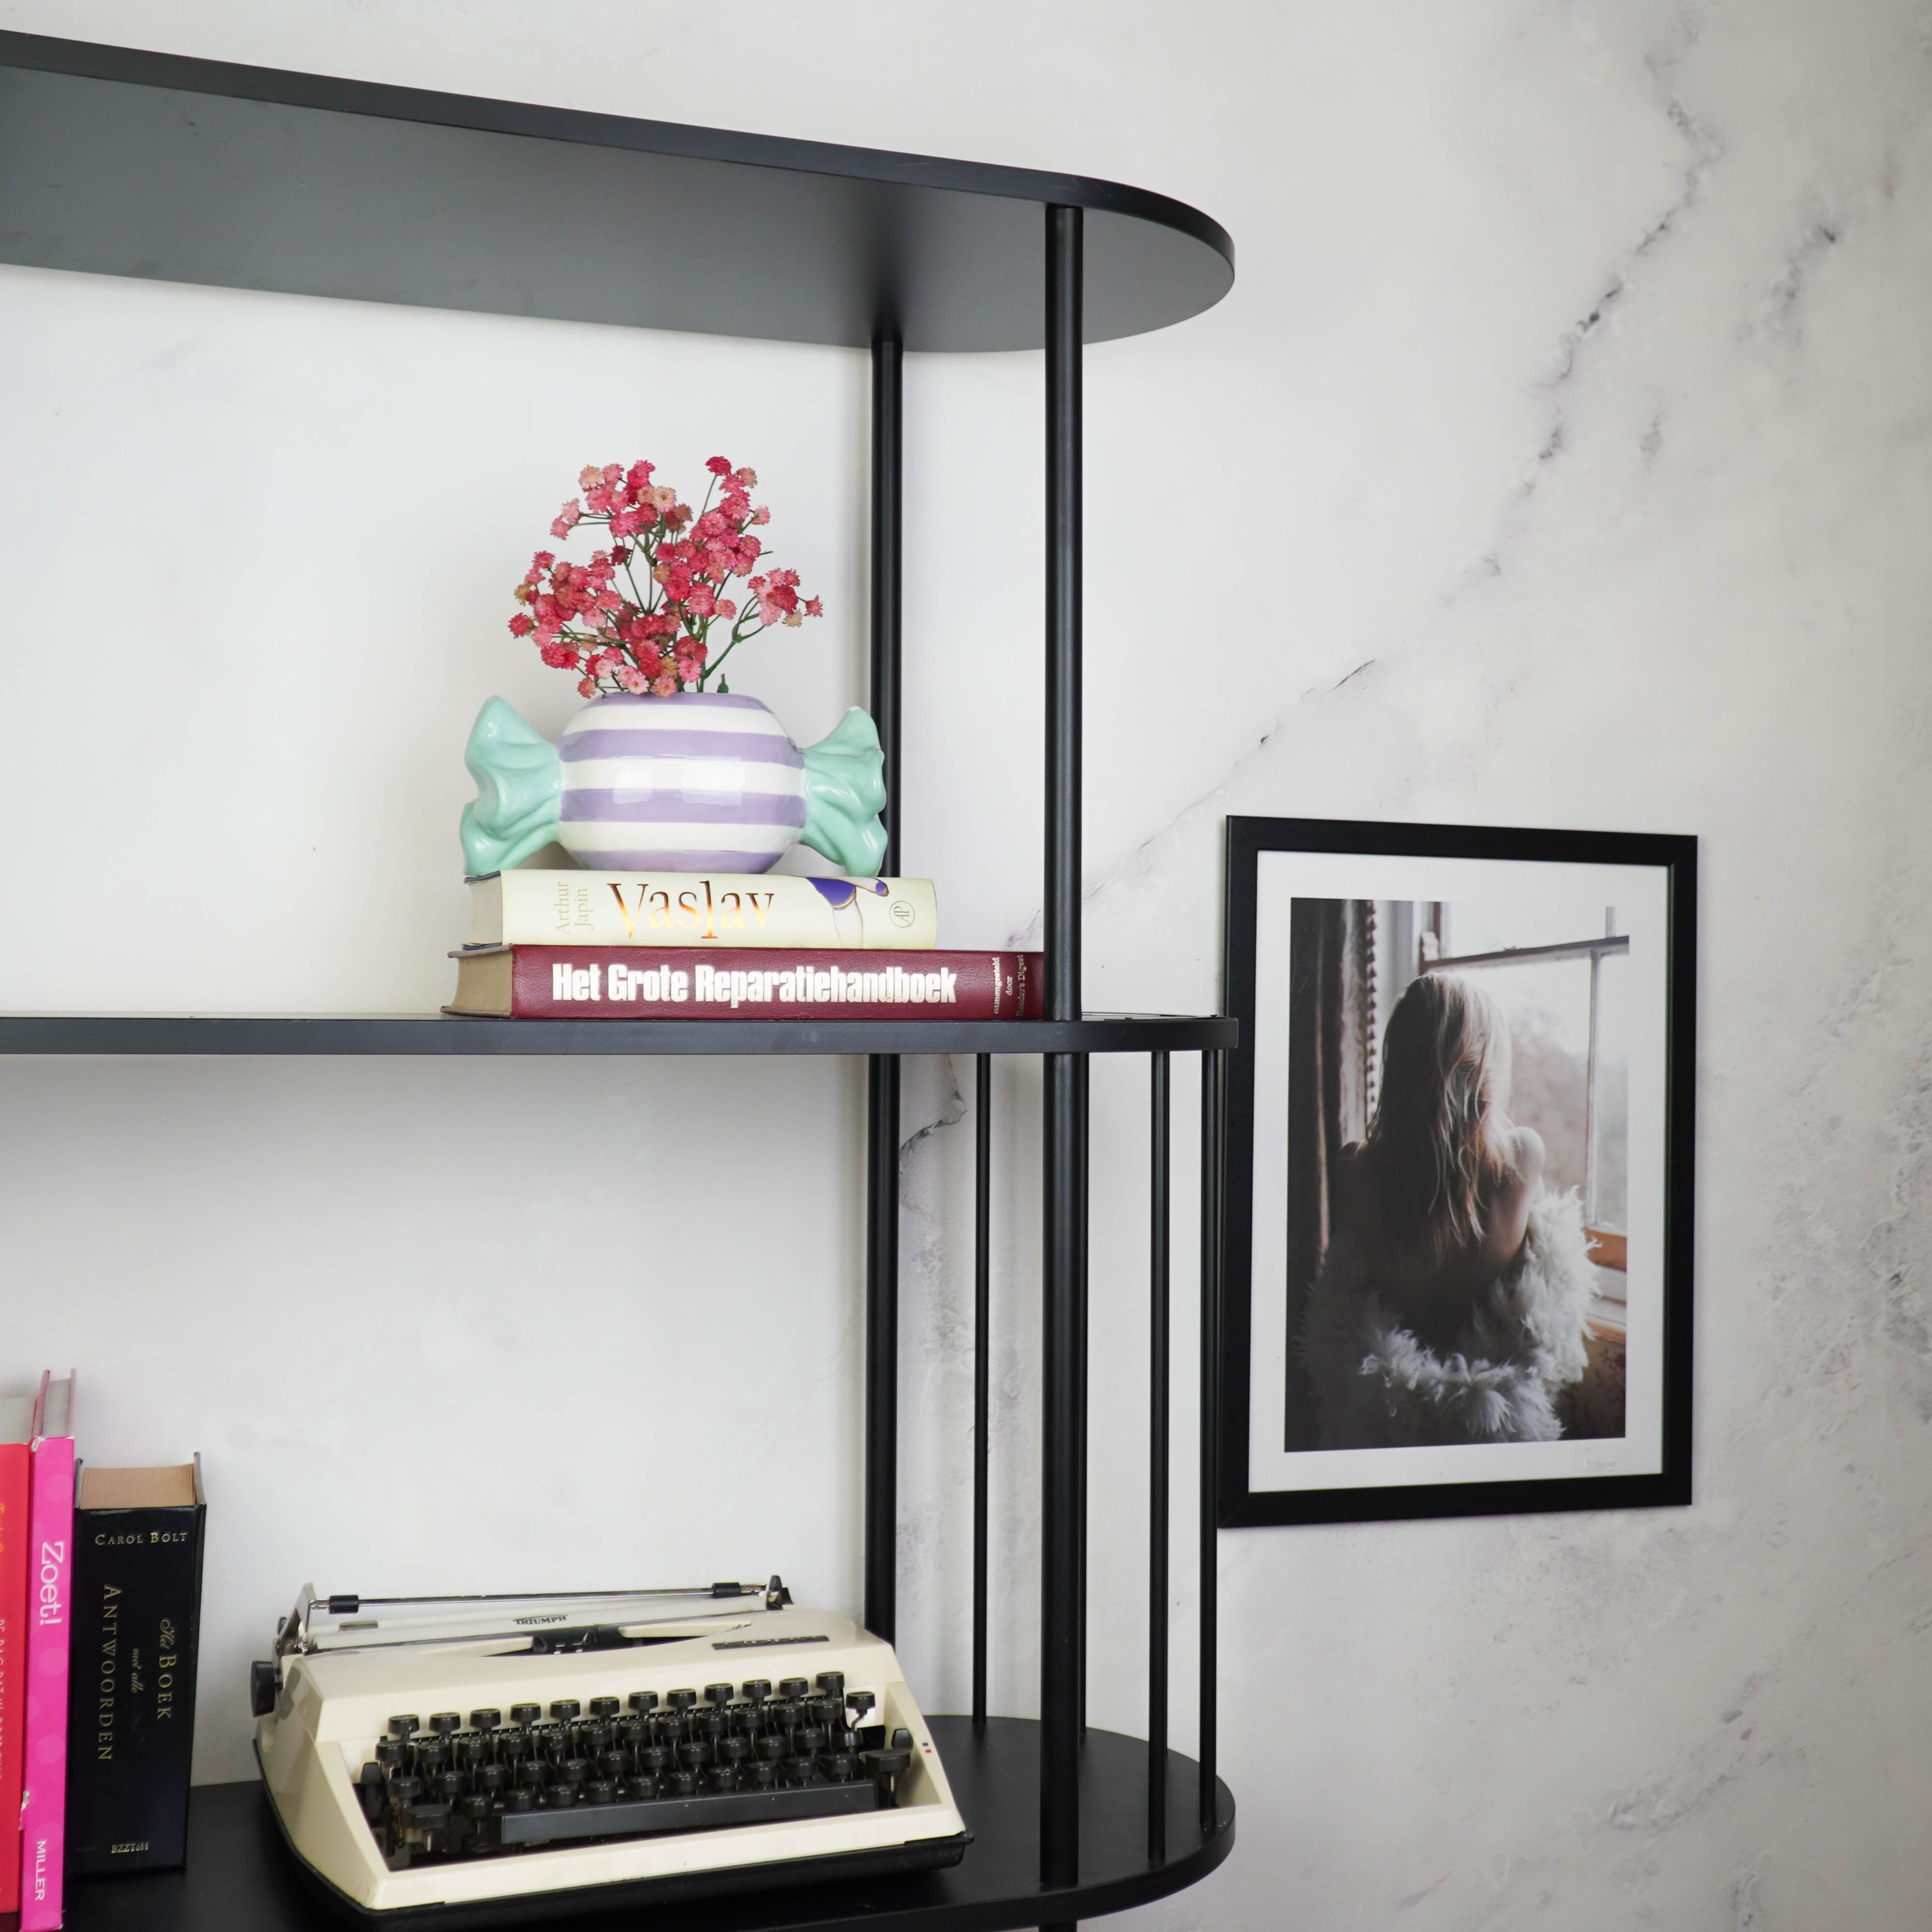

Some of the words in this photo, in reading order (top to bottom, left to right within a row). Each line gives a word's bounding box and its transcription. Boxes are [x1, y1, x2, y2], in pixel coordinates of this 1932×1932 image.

[554, 881, 570, 935] Arthur
[574, 888, 594, 930] Japin
[607, 881, 775, 938] Vaslav
[552, 964, 600, 1001] Het
[608, 964, 688, 1002] Grote
[695, 965, 957, 1009] Reparatiehandboek
[992, 957, 1003, 1014] samengesteld
[1017, 954, 1027, 981] Digest
[95, 1534, 143, 1546] CAROL
[150, 1532, 188, 1543] BOLT
[39, 1542, 65, 1626] Zoet!
[512, 1615, 568, 1625] TRIUMPH
[98, 1584, 122, 1760] ANTWOORDEN
[130, 1648, 142, 1670] met
[157, 1654, 177, 1720] BOEK
[34, 1839, 47, 1902] MILLER
